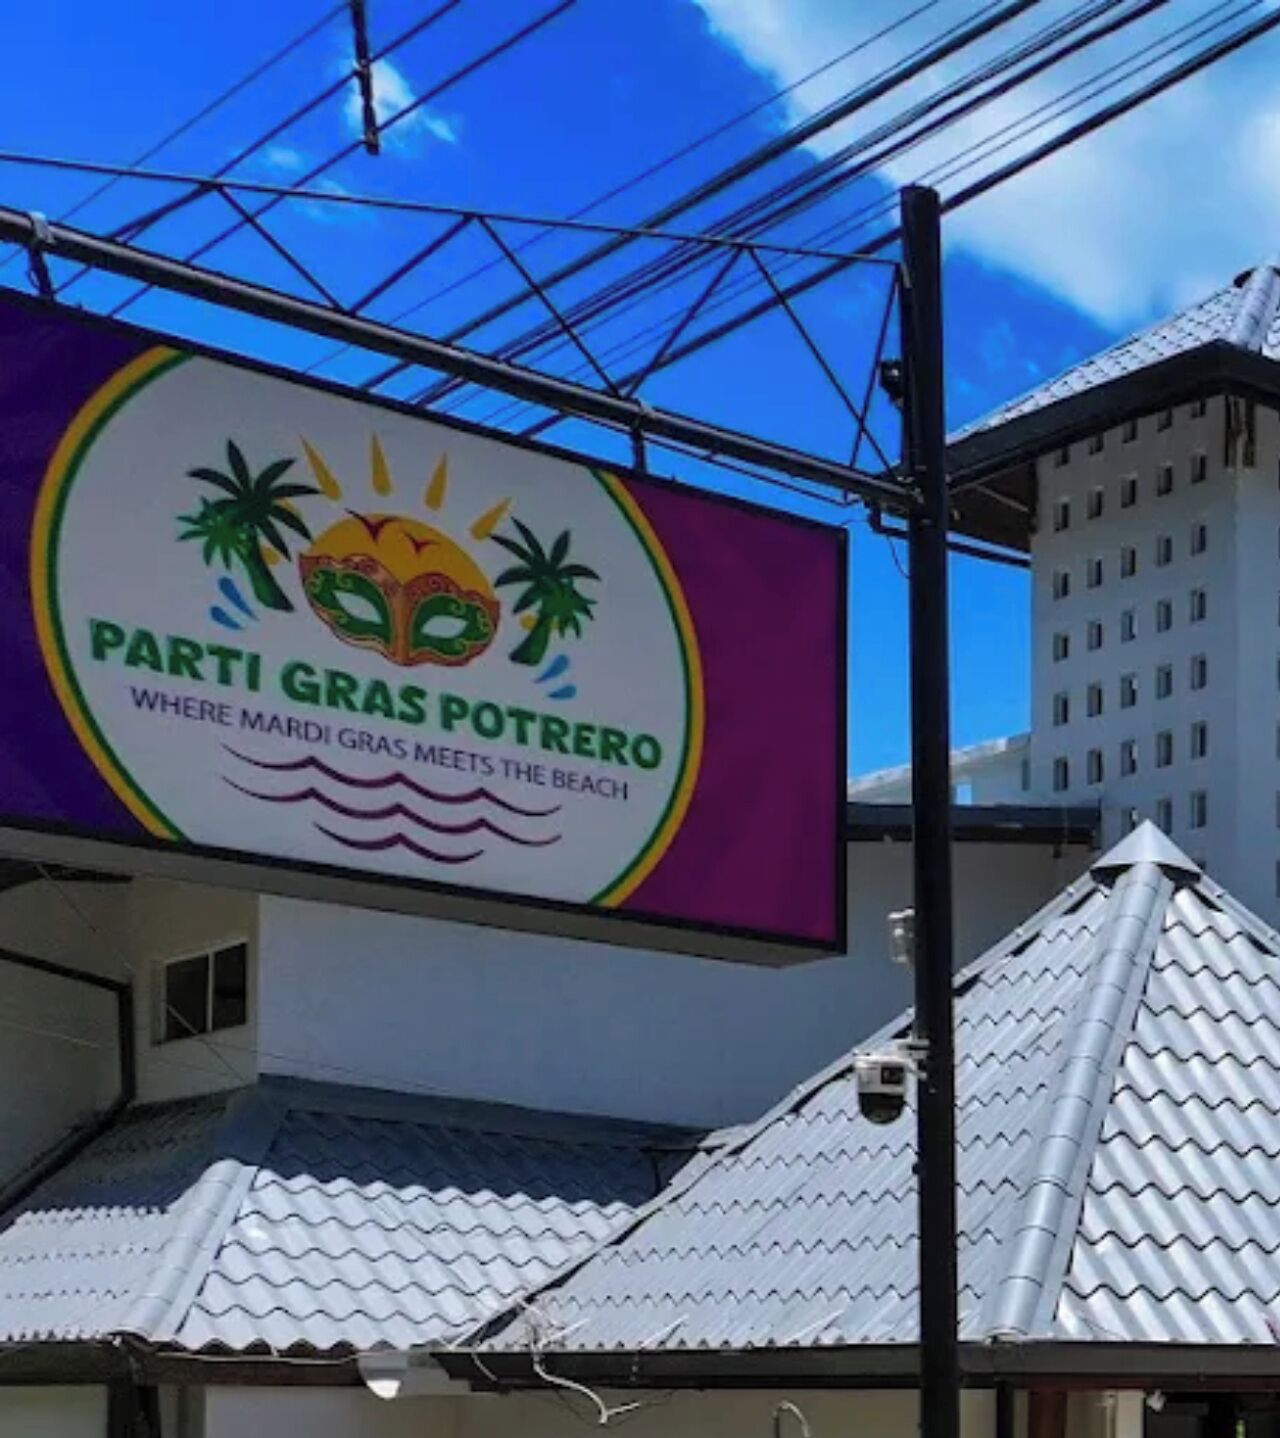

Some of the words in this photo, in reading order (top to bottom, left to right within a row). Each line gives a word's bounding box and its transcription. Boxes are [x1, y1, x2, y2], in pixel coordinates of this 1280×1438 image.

[89, 617, 261, 693] PARTI
[280, 660, 427, 725] GRAS
[440, 692, 662, 770] POTRERO
[129, 685, 233, 727] WHERE
[239, 708, 331, 747] MARDI
[337, 727, 408, 761] GRAS
[413, 743, 495, 777] MEETS
[500, 758, 547, 786] THE
[552, 768, 629, 801] BEACH
